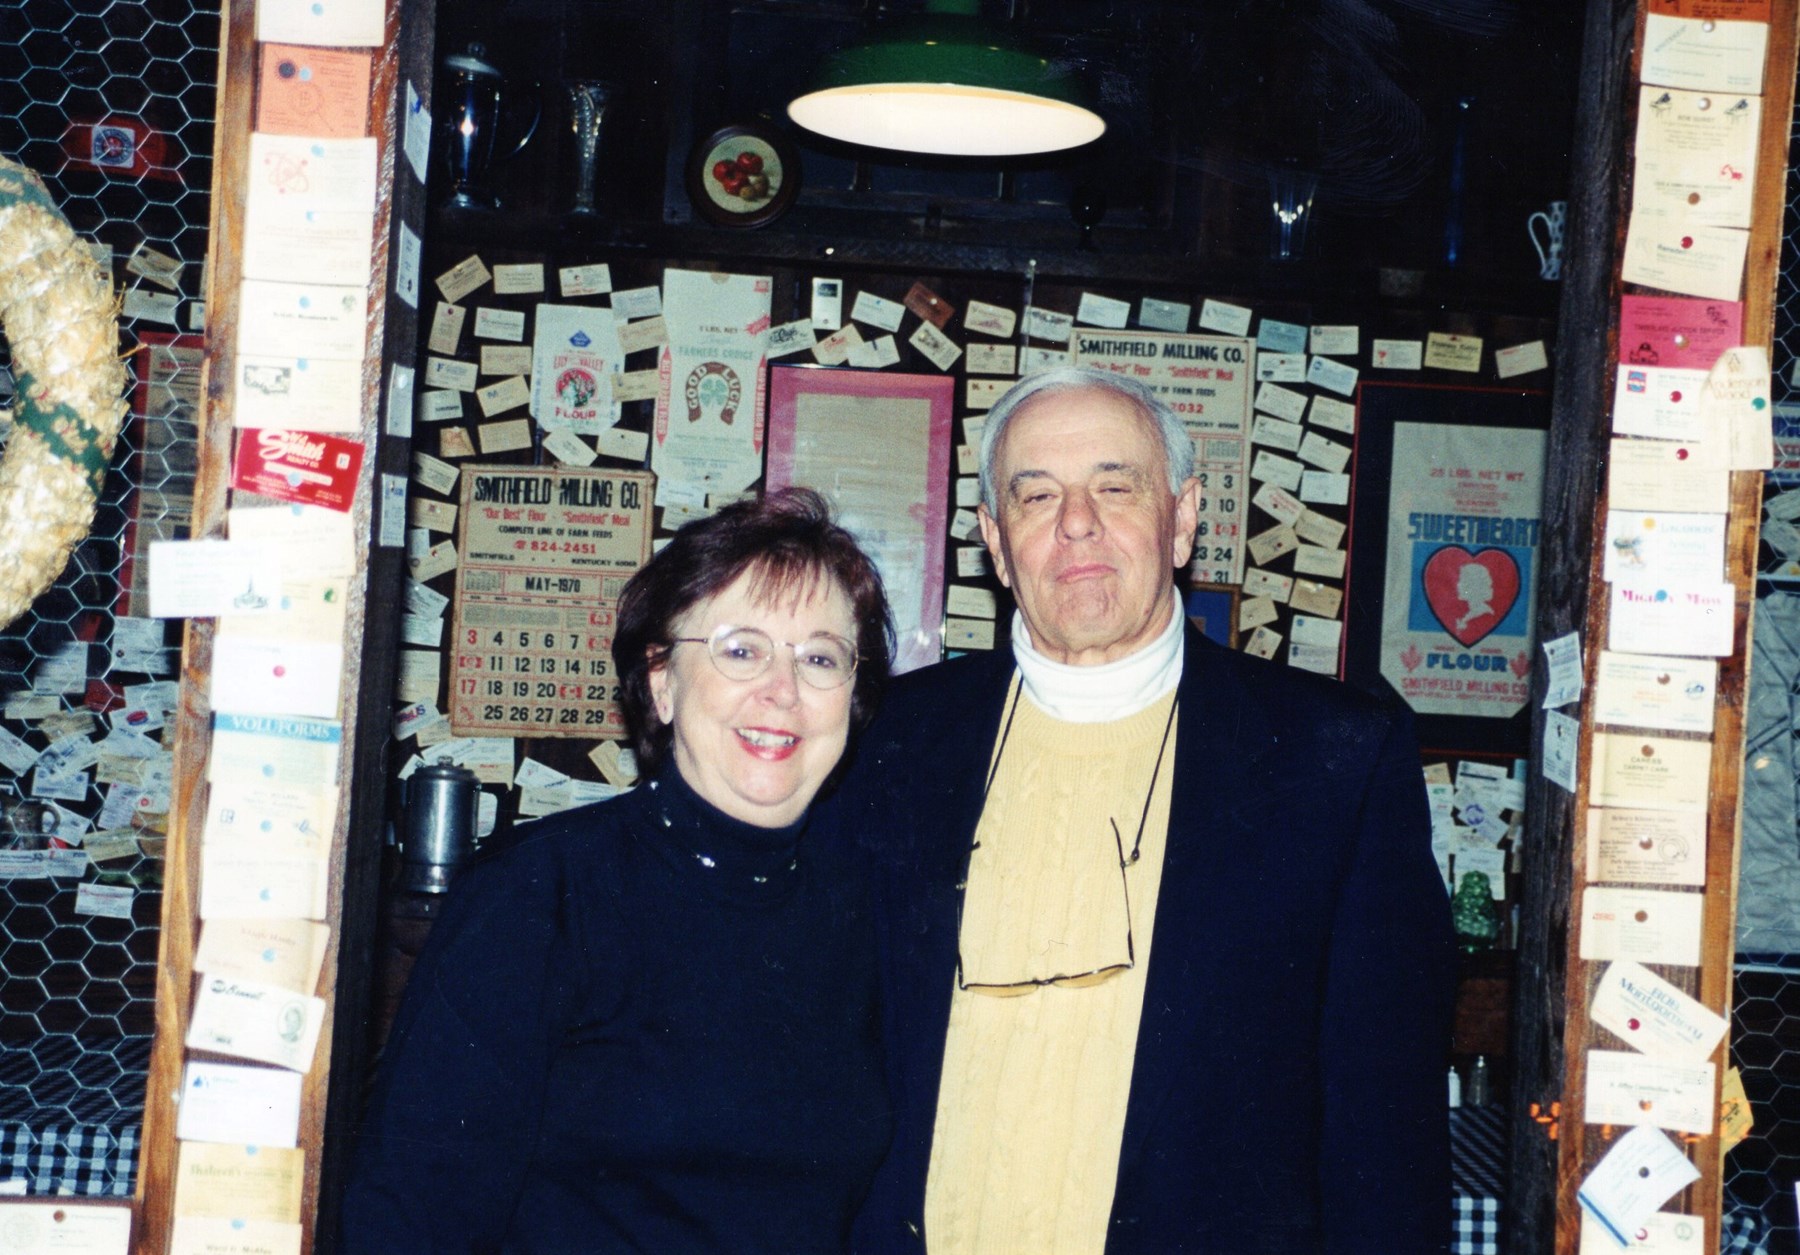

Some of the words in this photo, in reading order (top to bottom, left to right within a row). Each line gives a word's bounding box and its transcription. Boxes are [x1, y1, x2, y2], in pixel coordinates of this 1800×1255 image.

[1078, 339, 1157, 357] SMITHFIELD
[1162, 342, 1218, 361] MILLING
[1223, 346, 1246, 364] CO.
[579, 356, 605, 372] VALLEY
[688, 365, 708, 410] GOOD
[722, 367, 742, 411] LUCK
[555, 406, 597, 420] FLOUR
[1223, 473, 1234, 490] 3
[474, 476, 552, 505] SMITHFIELD
[559, 478, 613, 509] MILLING
[620, 482, 641, 510] CO.
[1219, 497, 1235, 513] 10
[503, 508, 526, 522] Best"
[528, 509, 546, 522] Flour
[562, 511, 609, 526] "Smithfield"
[612, 513, 630, 527] Meal
[498, 525, 535, 536] COMPLETE
[537, 526, 553, 537] LINE
[556, 527, 565, 537] OF
[568, 527, 588, 538] FARM
[592, 528, 613, 539] FEEDS
[1408, 511, 1541, 546] SWEETHEART
[530, 540, 597, 555] 824-2451
[1192, 545, 1208, 560] 23
[1214, 547, 1233, 562] 24
[469, 552, 515, 561] SMITHFIELD
[571, 557, 611, 567] KENTUCKY
[525, 576, 581, 593] MAY-1970
[1214, 570, 1229, 584] 31
[467, 629, 478, 645] 3
[492, 631, 503, 646] 4
[519, 632, 530, 647] 5
[544, 633, 554, 648] 6
[570, 634, 579, 650] 7
[490, 656, 503, 671] 11
[515, 657, 531, 673] 12
[540, 658, 556, 673] 13
[565, 659, 580, 675] 14
[590, 660, 606, 676] 15
[1426, 653, 1508, 672] FLOUR
[460, 679, 477, 695] 17
[487, 680, 503, 695] 18
[513, 681, 529, 697] 19
[537, 682, 556, 698] 20
[586, 685, 606, 701] 22
[1402, 677, 1463, 691] SMITHFIELD
[1467, 680, 1509, 694] MILLING
[484, 705, 503, 720] 25
[509, 706, 529, 721] 26
[535, 707, 554, 723] 27
[560, 708, 579, 724] 28
[585, 709, 605, 725] 29
